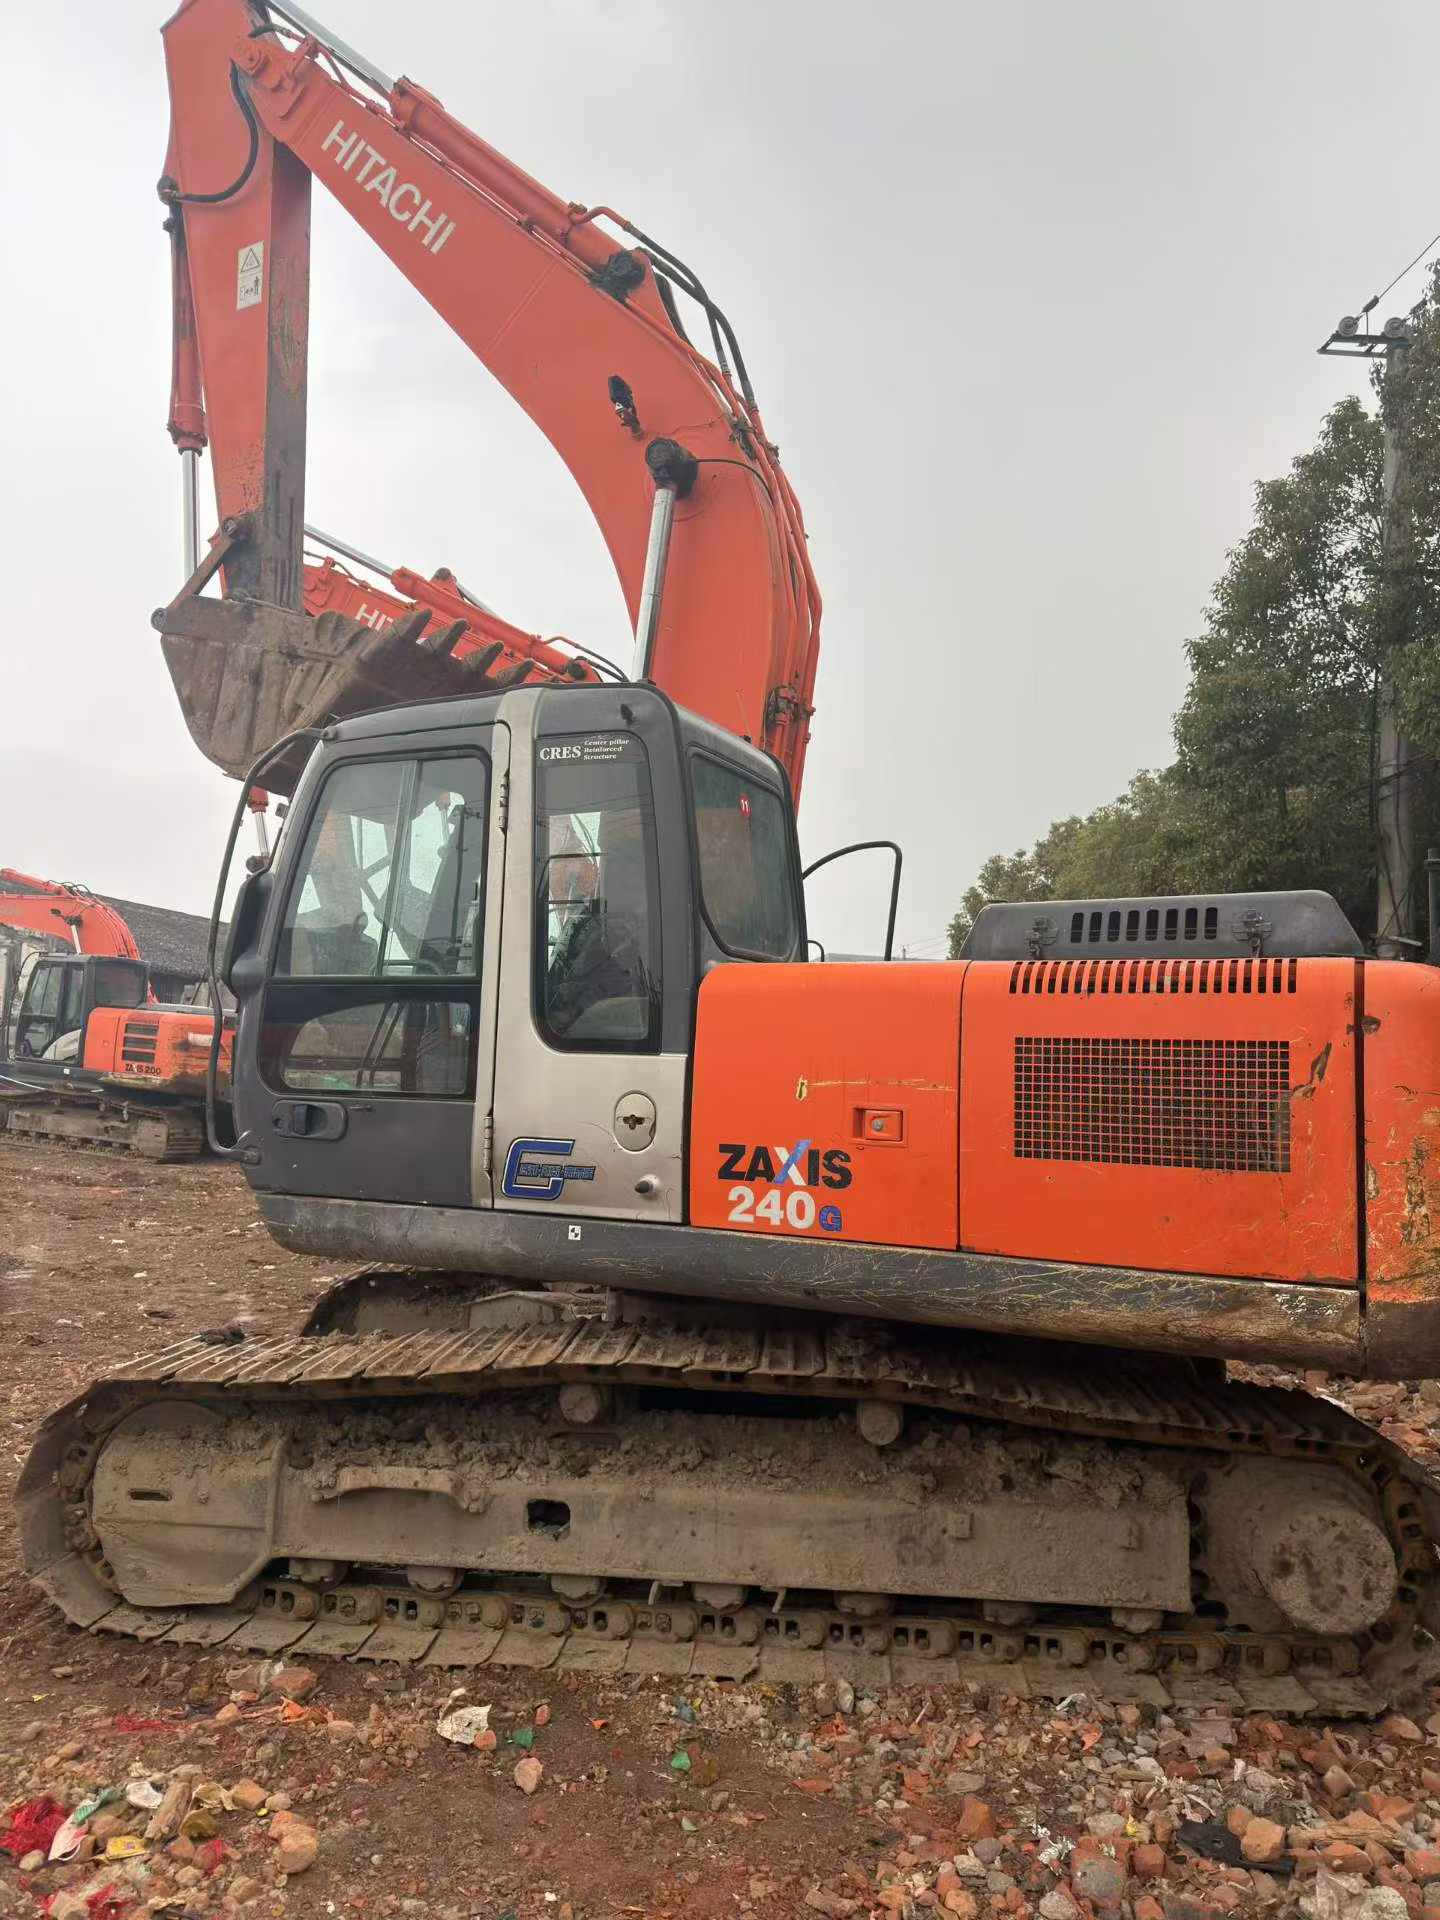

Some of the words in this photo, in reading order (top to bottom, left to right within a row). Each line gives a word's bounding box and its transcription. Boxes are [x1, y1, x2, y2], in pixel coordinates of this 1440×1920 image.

[320, 119, 457, 255] HITACHI
[539, 745, 582, 761] CRES
[717, 1139, 853, 1190] ZAXIS
